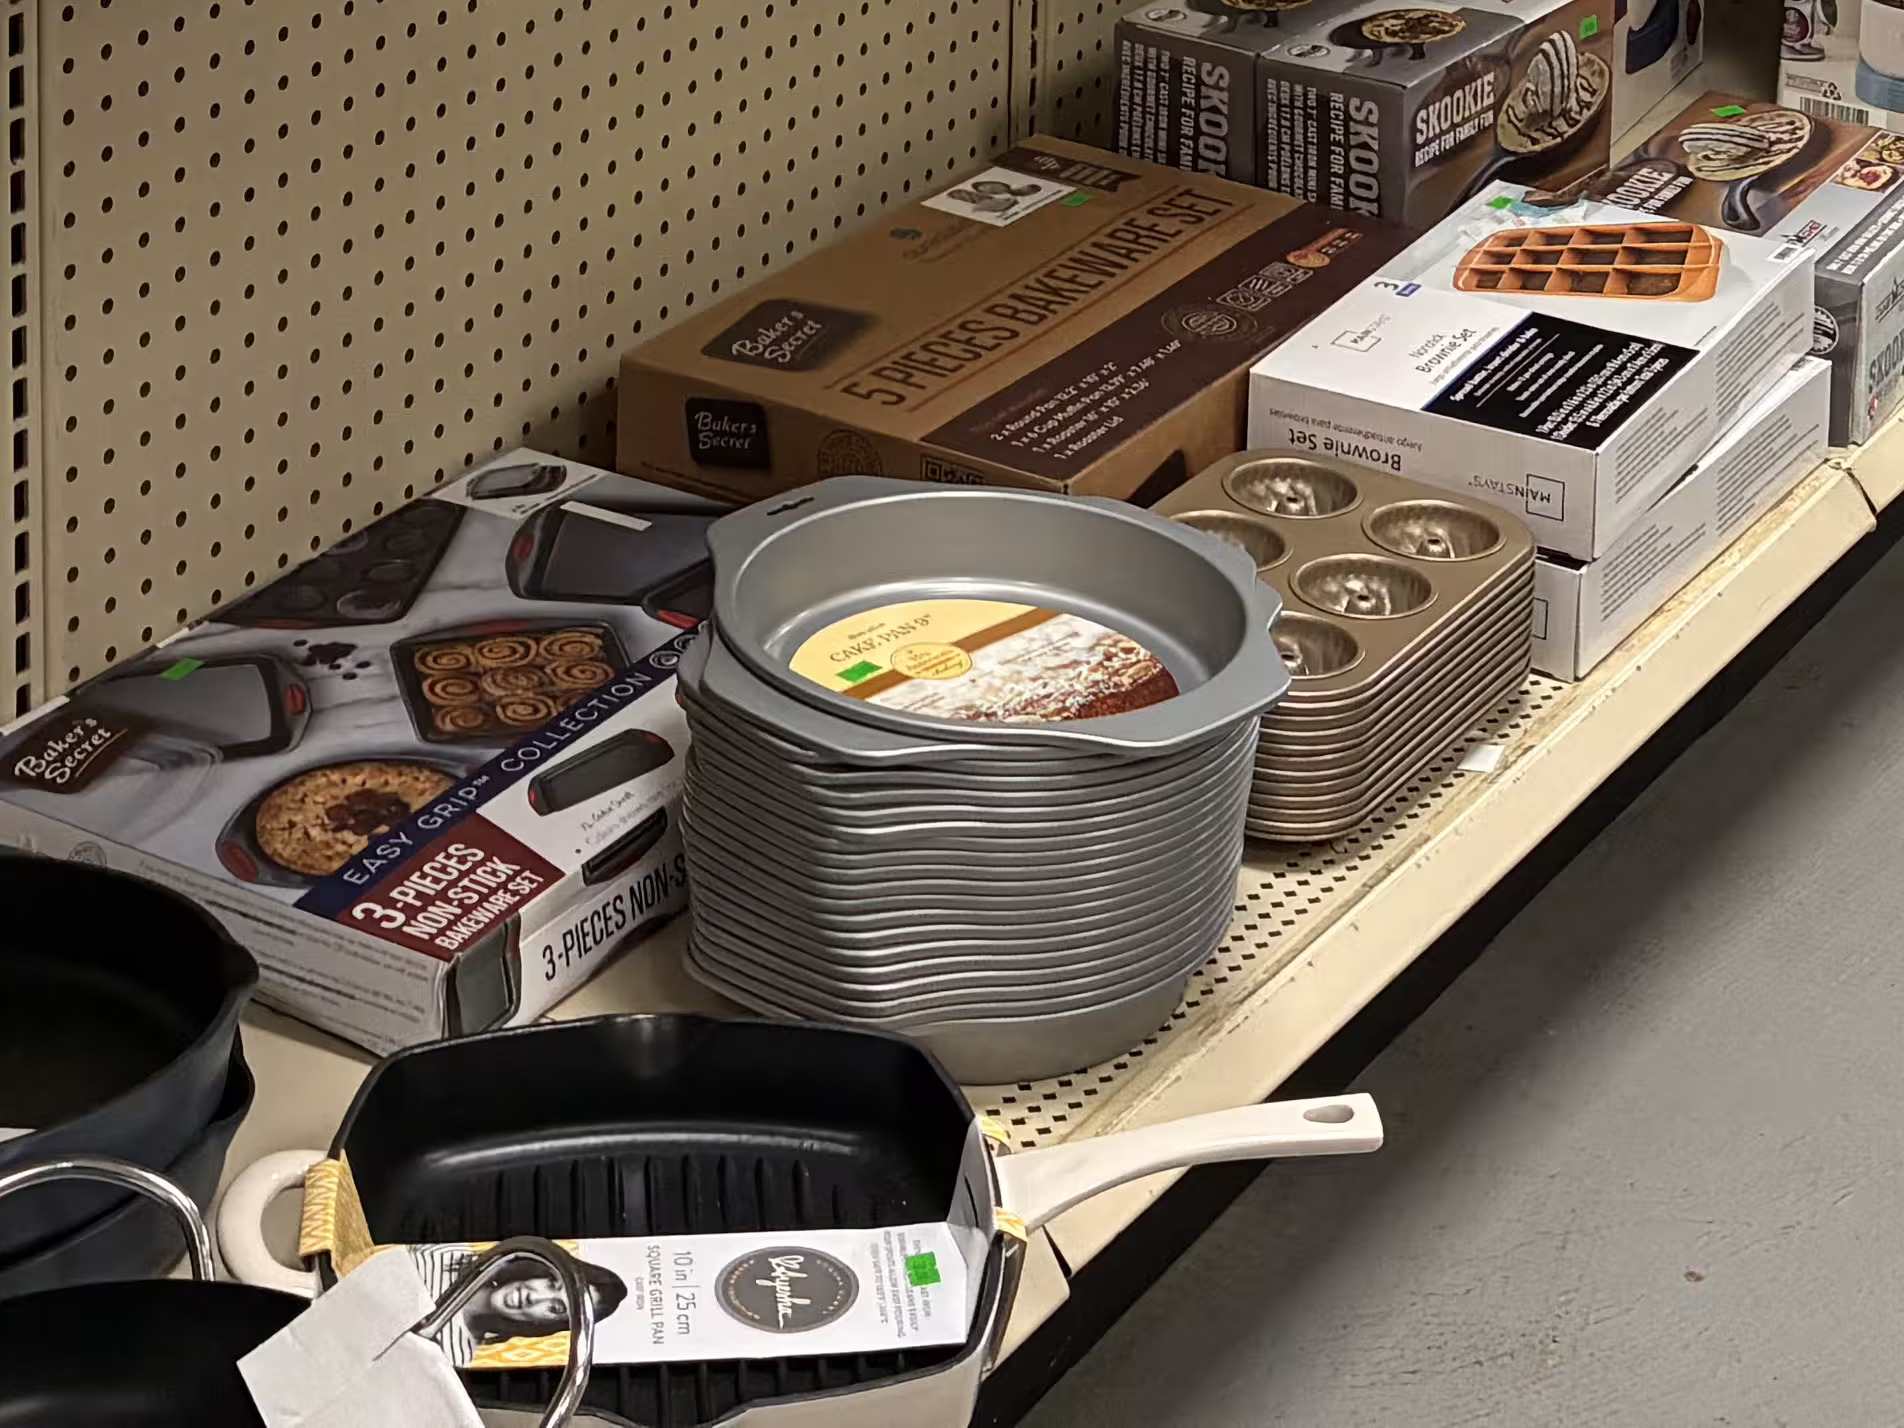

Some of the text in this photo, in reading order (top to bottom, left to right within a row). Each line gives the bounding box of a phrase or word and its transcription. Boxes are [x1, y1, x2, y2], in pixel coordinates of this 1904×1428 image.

[1415, 72, 1495, 144] SKOOKIE
[841, 190, 1237, 406] 5 PIECES BAKEWARE SET
[695, 410, 757, 435] Baker's
[698, 431, 754, 452] Secret
[1289, 428, 1402, 471] Brownie Set
[1473, 474, 1551, 504] MAINSTAYS
[13, 715, 99, 782] Baker's
[43, 726, 113, 786] Secret
[342, 838, 412, 887] EASY
[499, 671, 655, 774] COLLECTION
[351, 843, 485, 931] 3-PIECES
[403, 856, 520, 942] NON-STICK
[433, 870, 546, 953] BAKEWARE SET
[647, 1244, 664, 1344] SQUARE GRILL PAN
[673, 1251, 696, 1335] 10 in 25 cm
